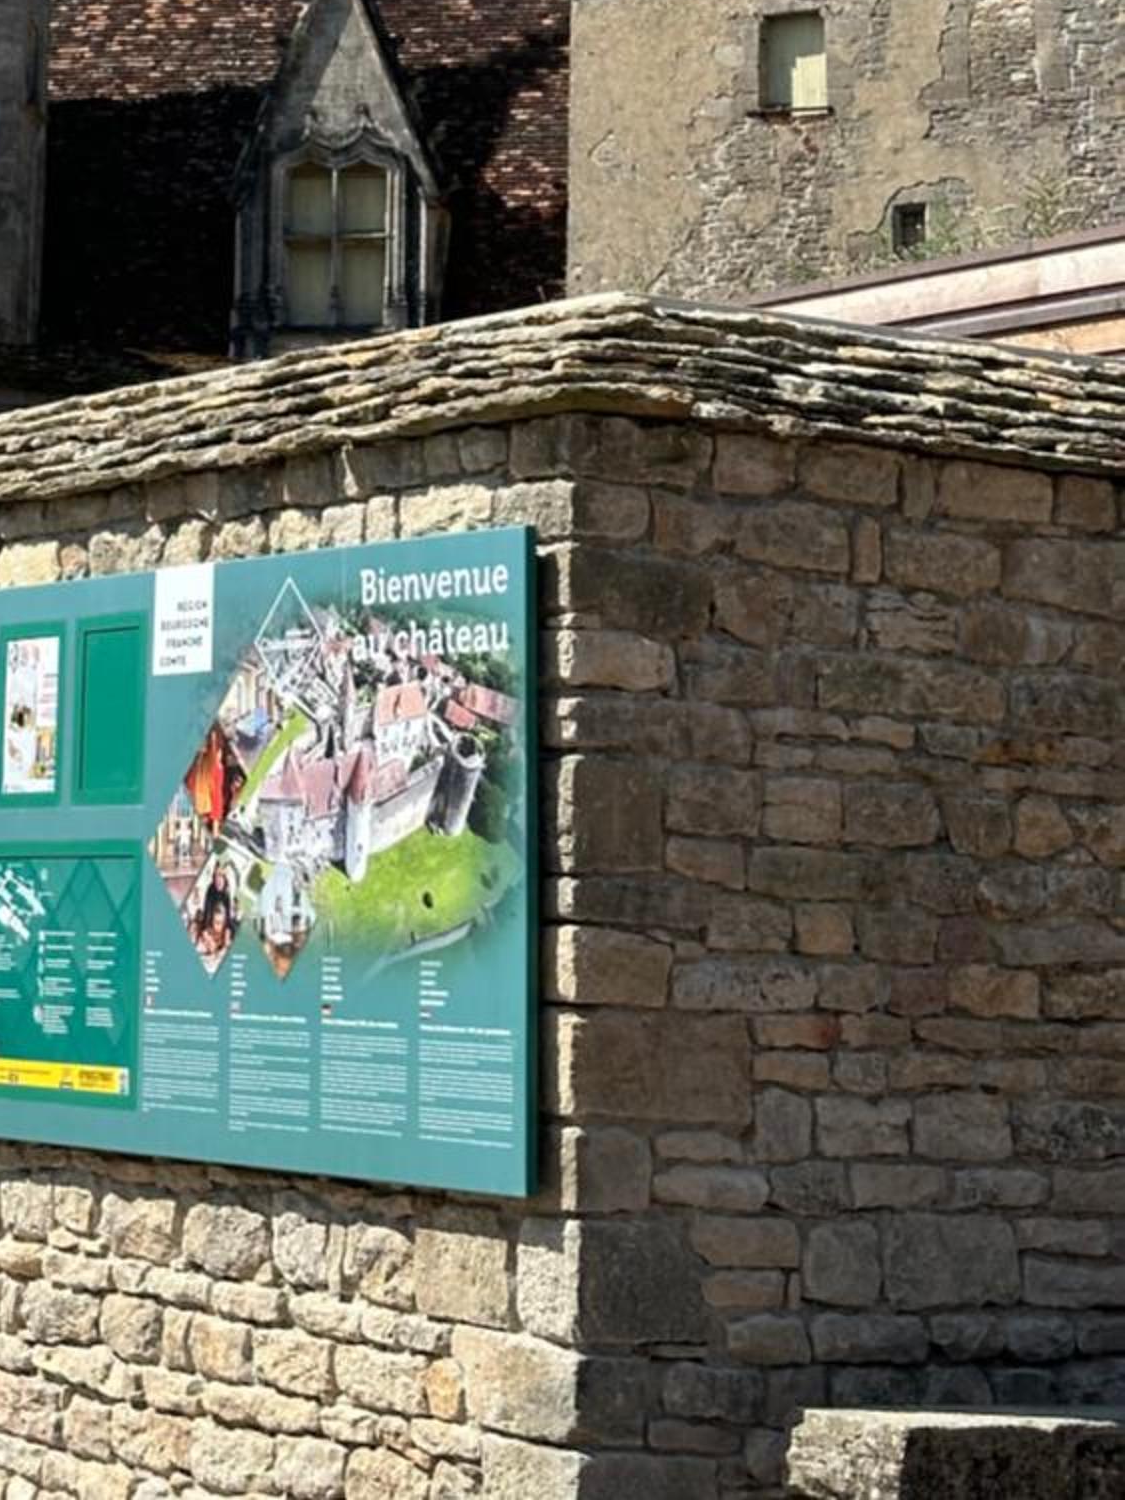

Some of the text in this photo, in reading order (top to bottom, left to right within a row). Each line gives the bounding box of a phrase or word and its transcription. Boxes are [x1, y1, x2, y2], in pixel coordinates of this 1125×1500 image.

[359, 563, 509, 606] Bienvenue
[352, 617, 510, 662] au château
